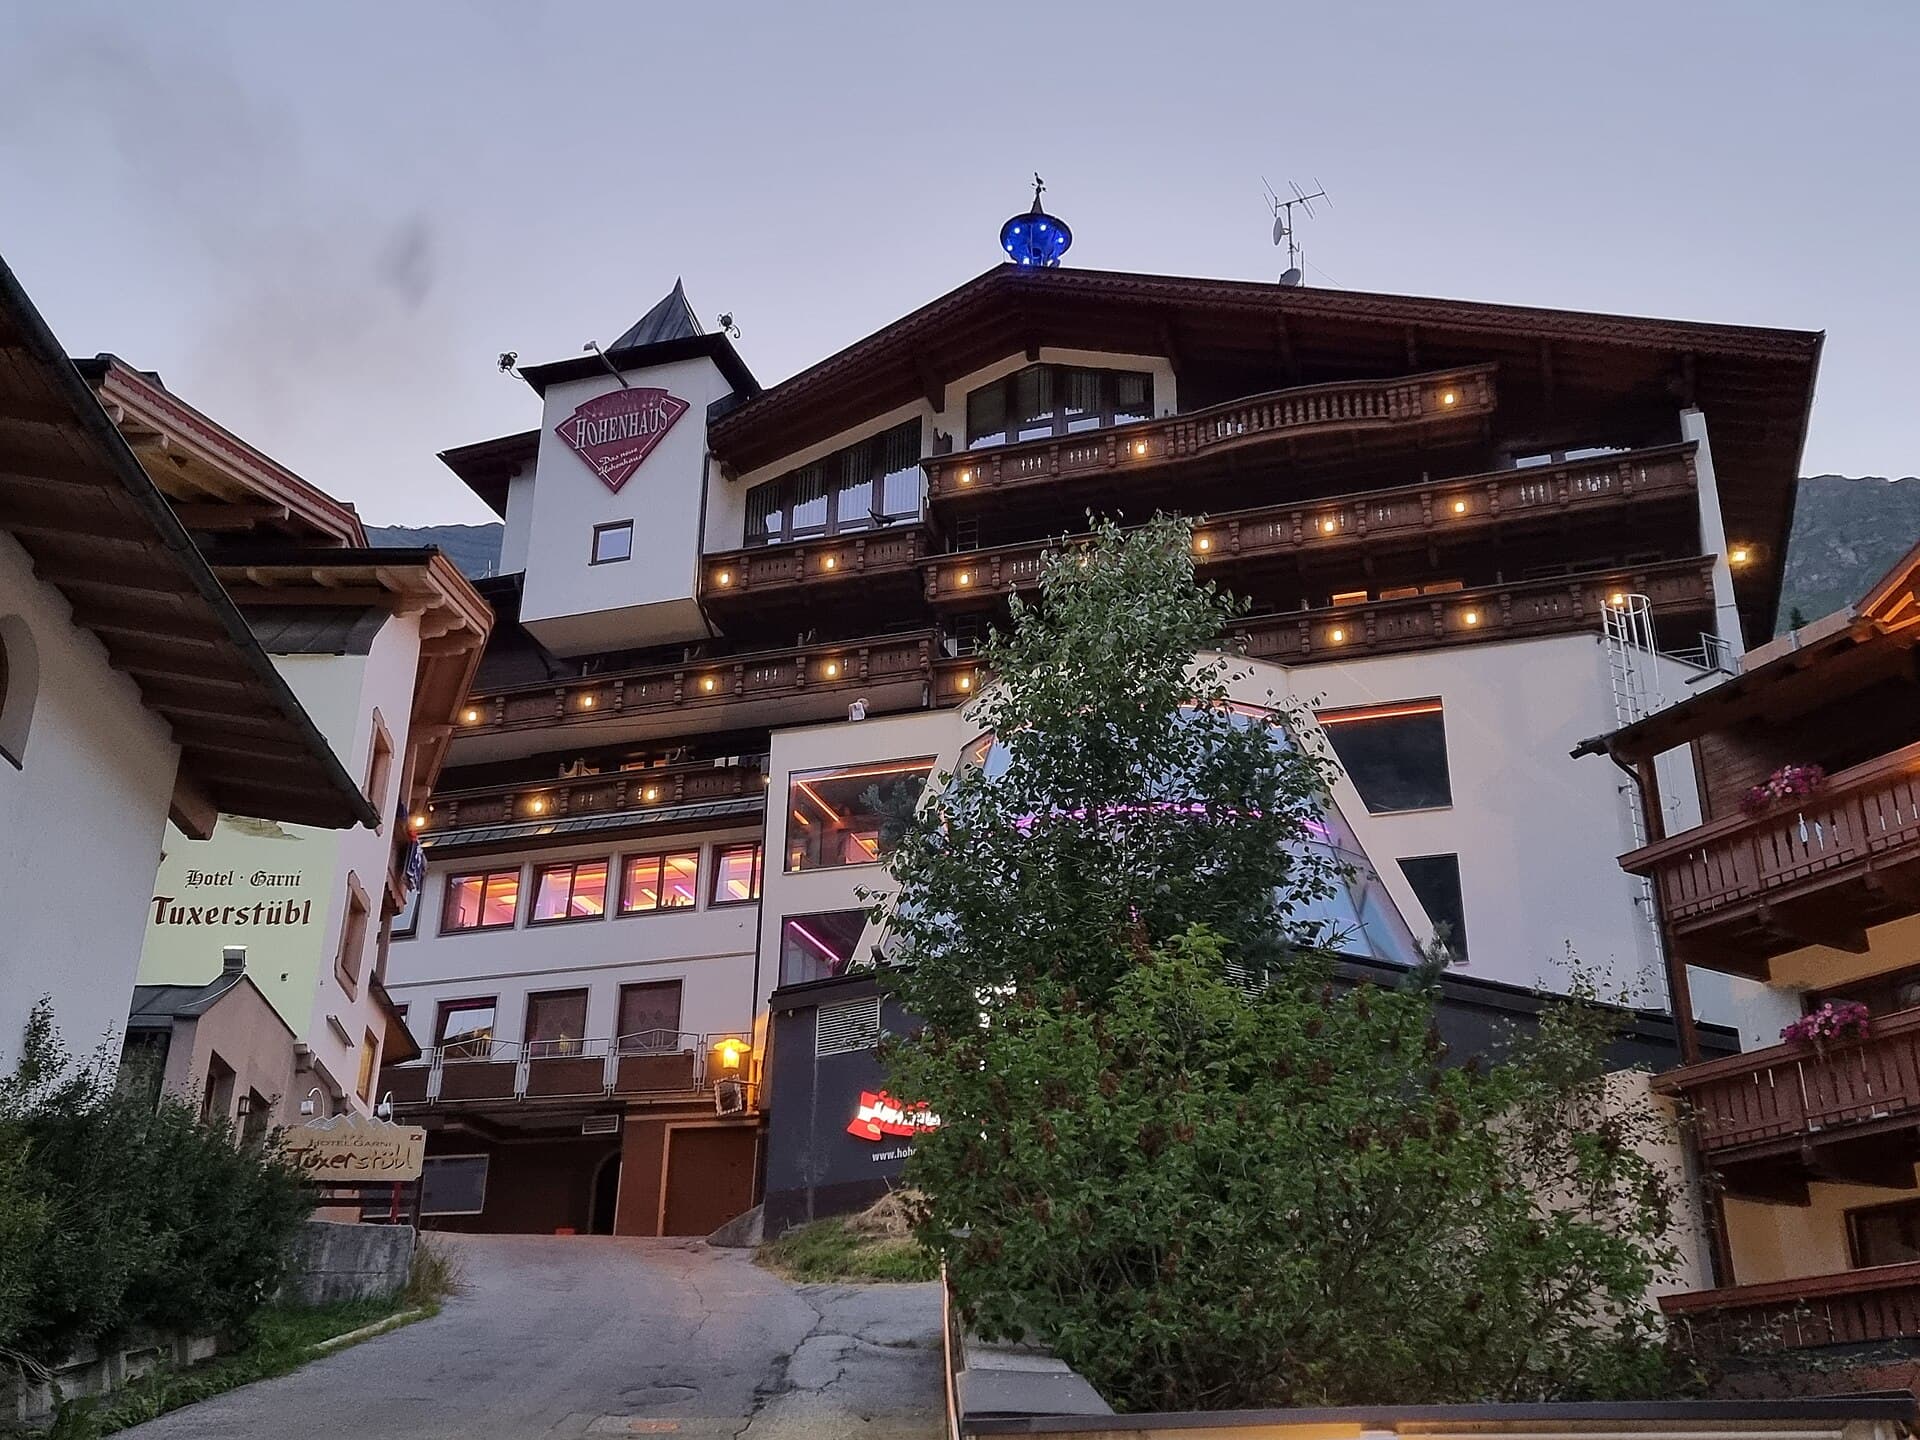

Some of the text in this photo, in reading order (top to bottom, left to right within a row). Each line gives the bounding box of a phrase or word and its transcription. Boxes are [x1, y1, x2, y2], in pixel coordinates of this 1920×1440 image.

[574, 400, 669, 450] HOHENHAUS
[185, 869, 302, 889] Hotel Garni
[151, 896, 312, 926] Tuxerstübl
[353, 1138, 392, 1148] GARNI
